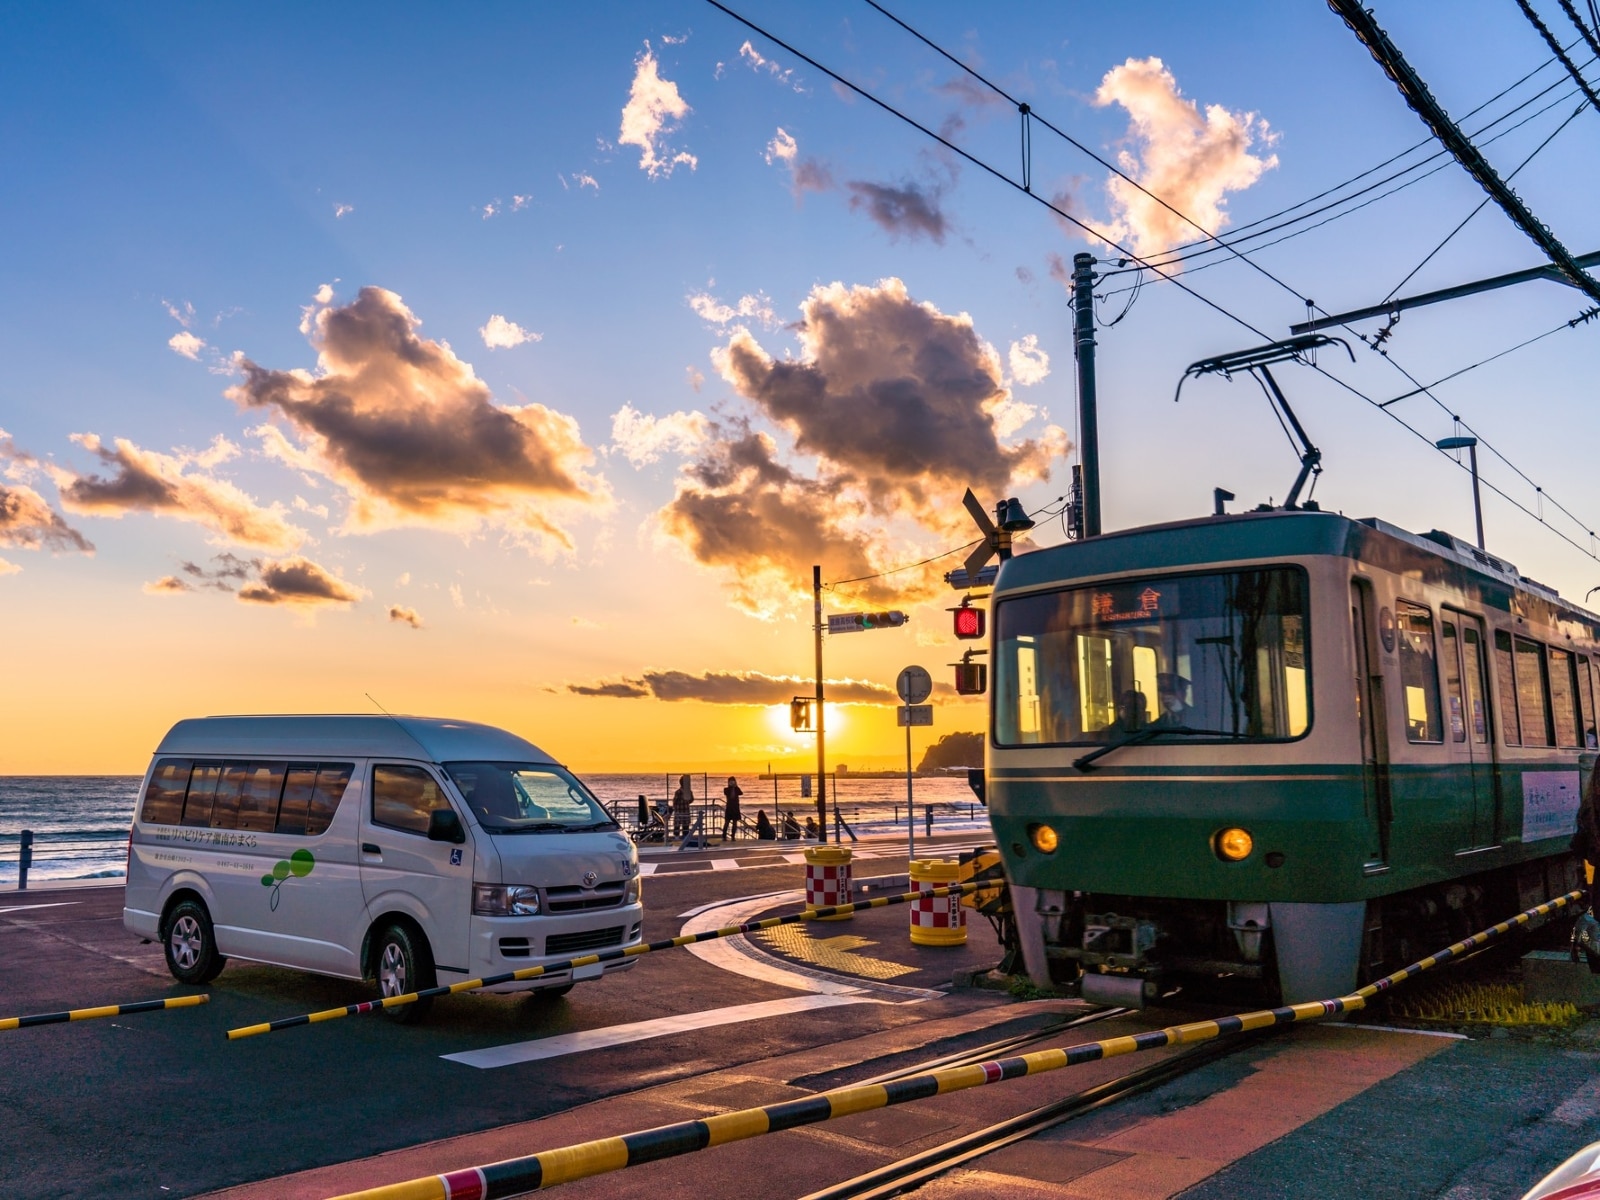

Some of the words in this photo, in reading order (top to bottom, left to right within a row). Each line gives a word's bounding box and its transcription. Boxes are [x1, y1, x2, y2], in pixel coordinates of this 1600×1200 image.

[172, 829, 257, 848] リハビリケア湘南かまくら
